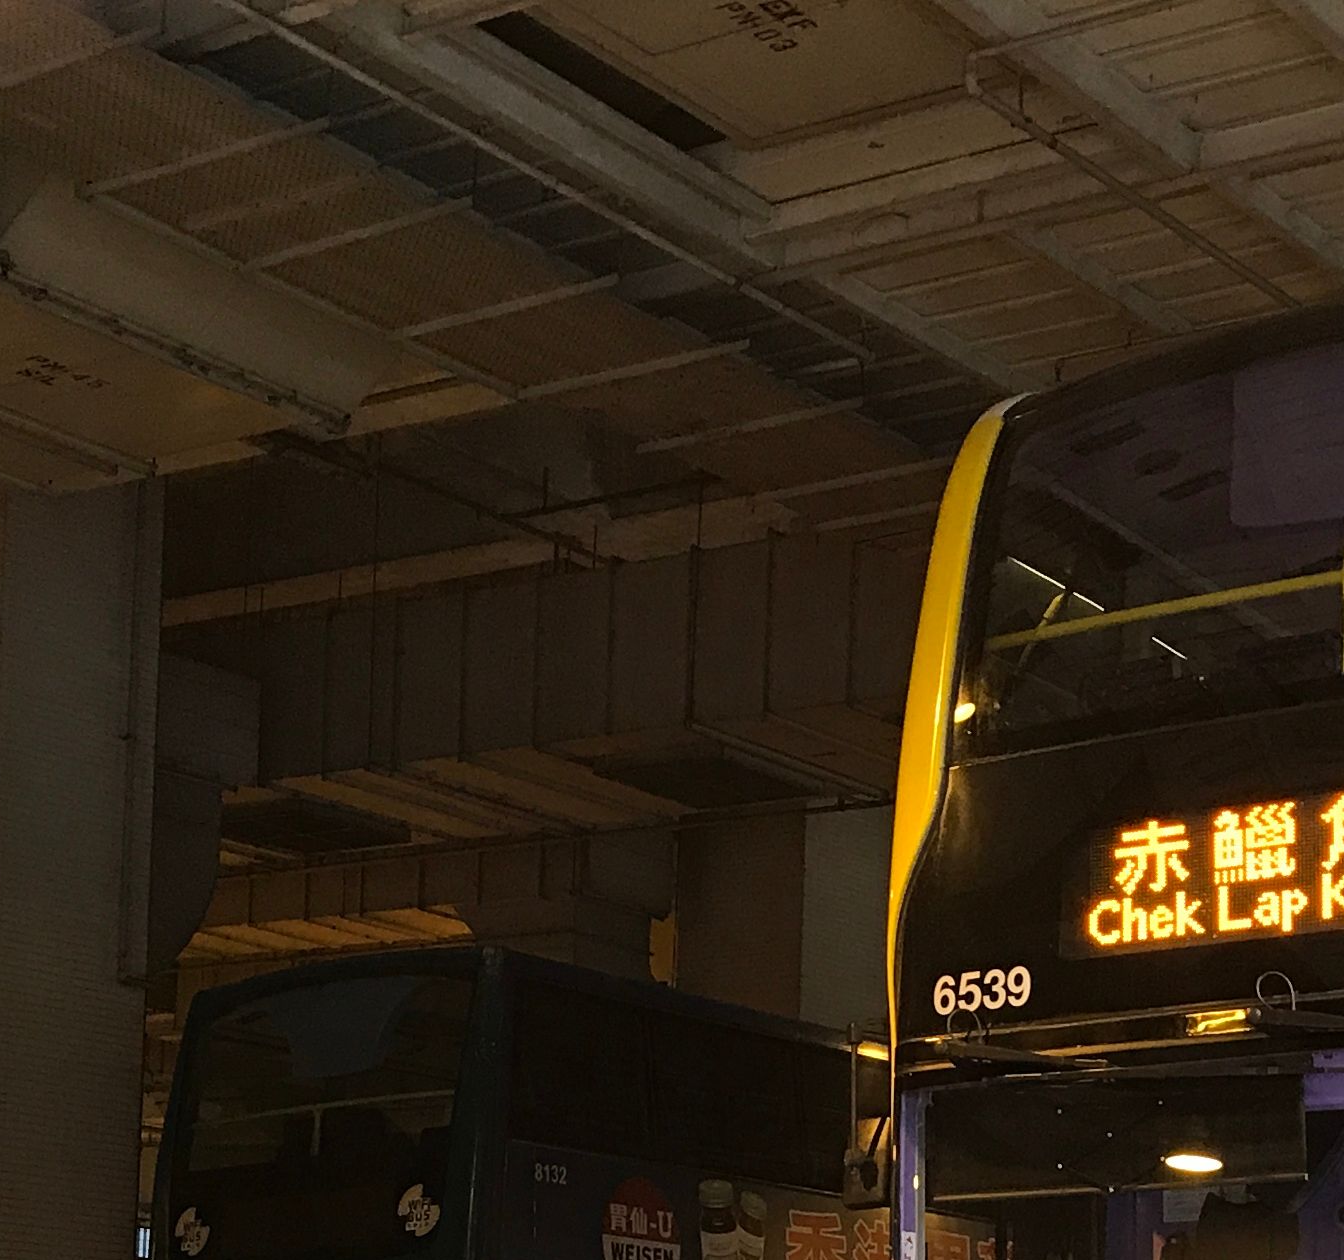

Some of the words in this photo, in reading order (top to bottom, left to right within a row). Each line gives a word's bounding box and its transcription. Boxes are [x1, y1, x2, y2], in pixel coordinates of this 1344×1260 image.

[1088, 890, 1206, 944] Chek
[1217, 876, 1308, 932] Lap
[933, 965, 1032, 1016] 6539
[534, 1162, 568, 1185] 8132
[609, 1202, 674, 1239] 胃仙-U
